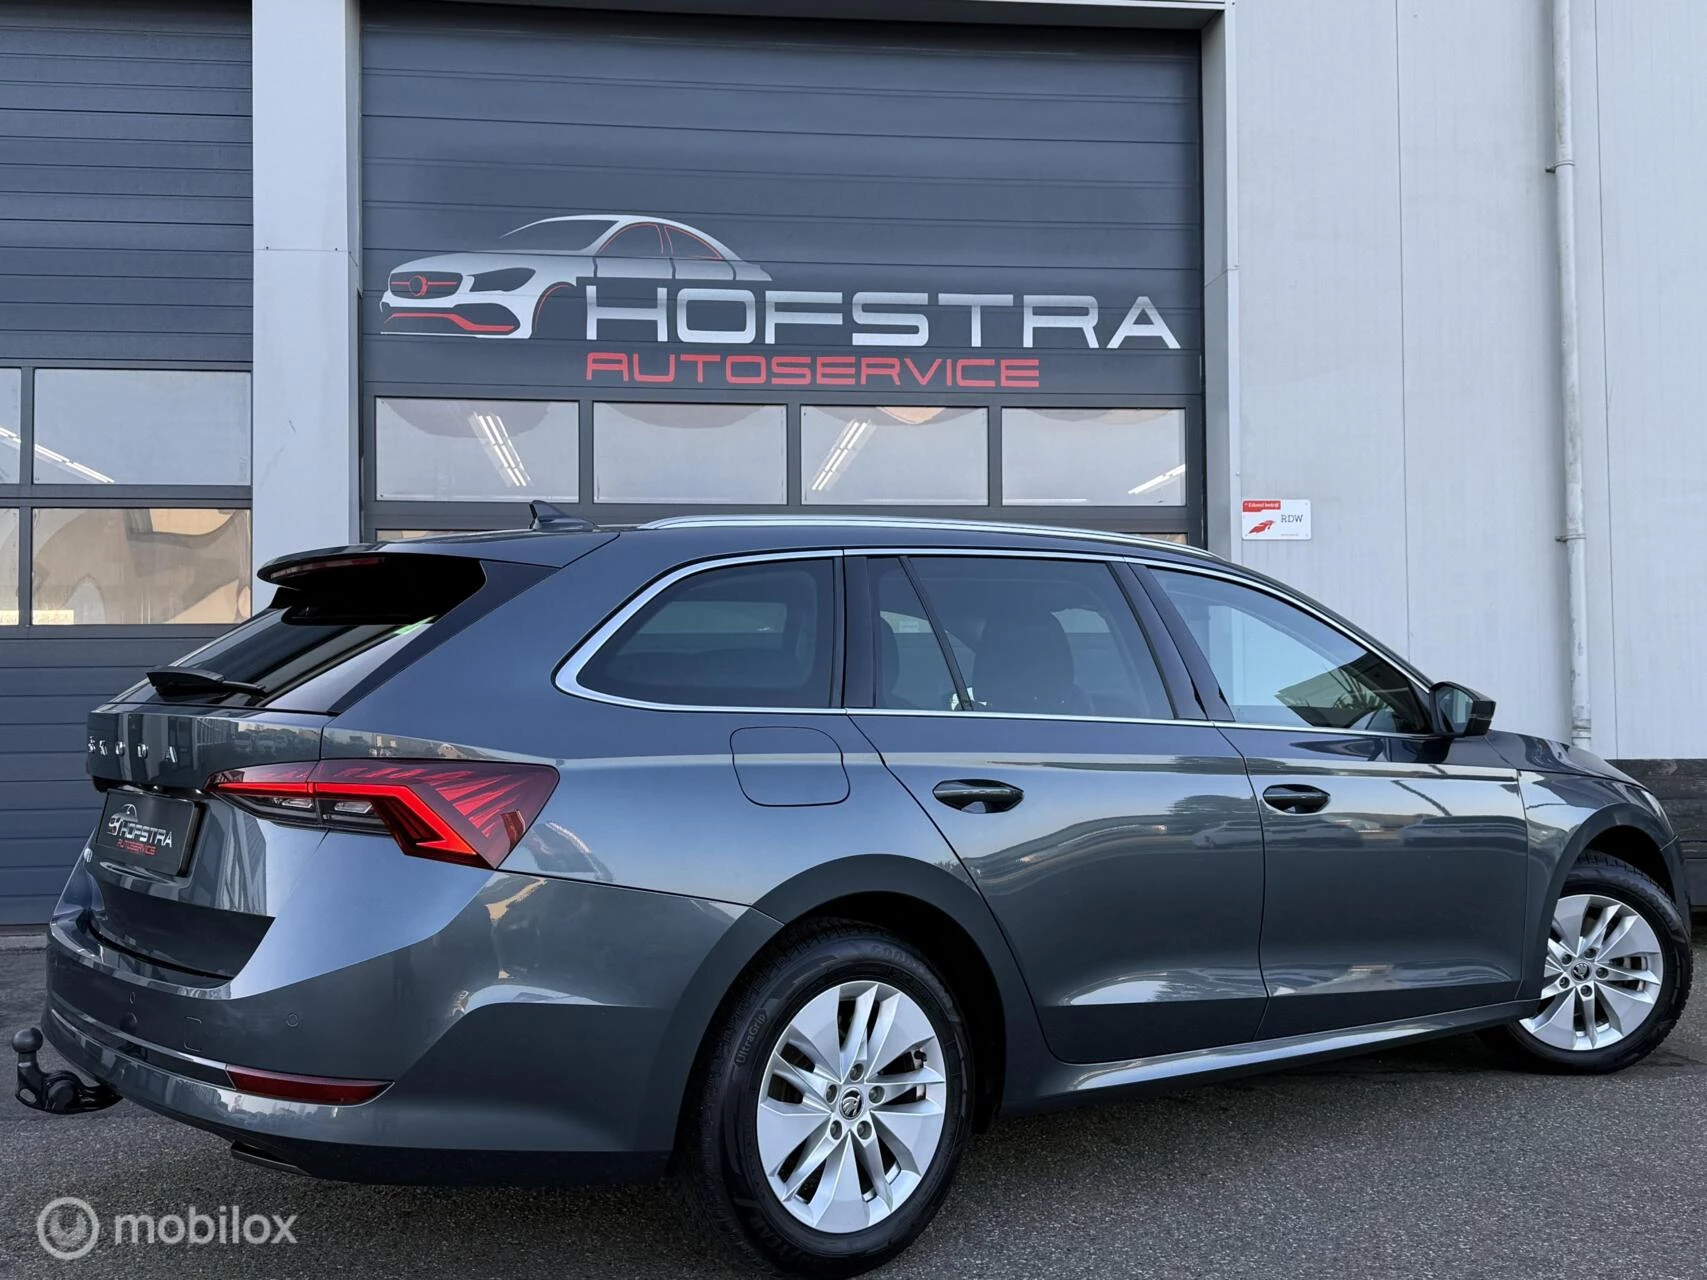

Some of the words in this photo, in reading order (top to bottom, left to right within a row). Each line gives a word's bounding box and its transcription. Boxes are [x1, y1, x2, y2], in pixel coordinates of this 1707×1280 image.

[585, 284, 1181, 350] HOFSTRA
[585, 351, 1041, 389] AUTOSERVICE
[1280, 514, 1304, 524] RDW
[119, 821, 173, 848] HOFSTRA
[735, 1013, 767, 1064] UltraGrip
